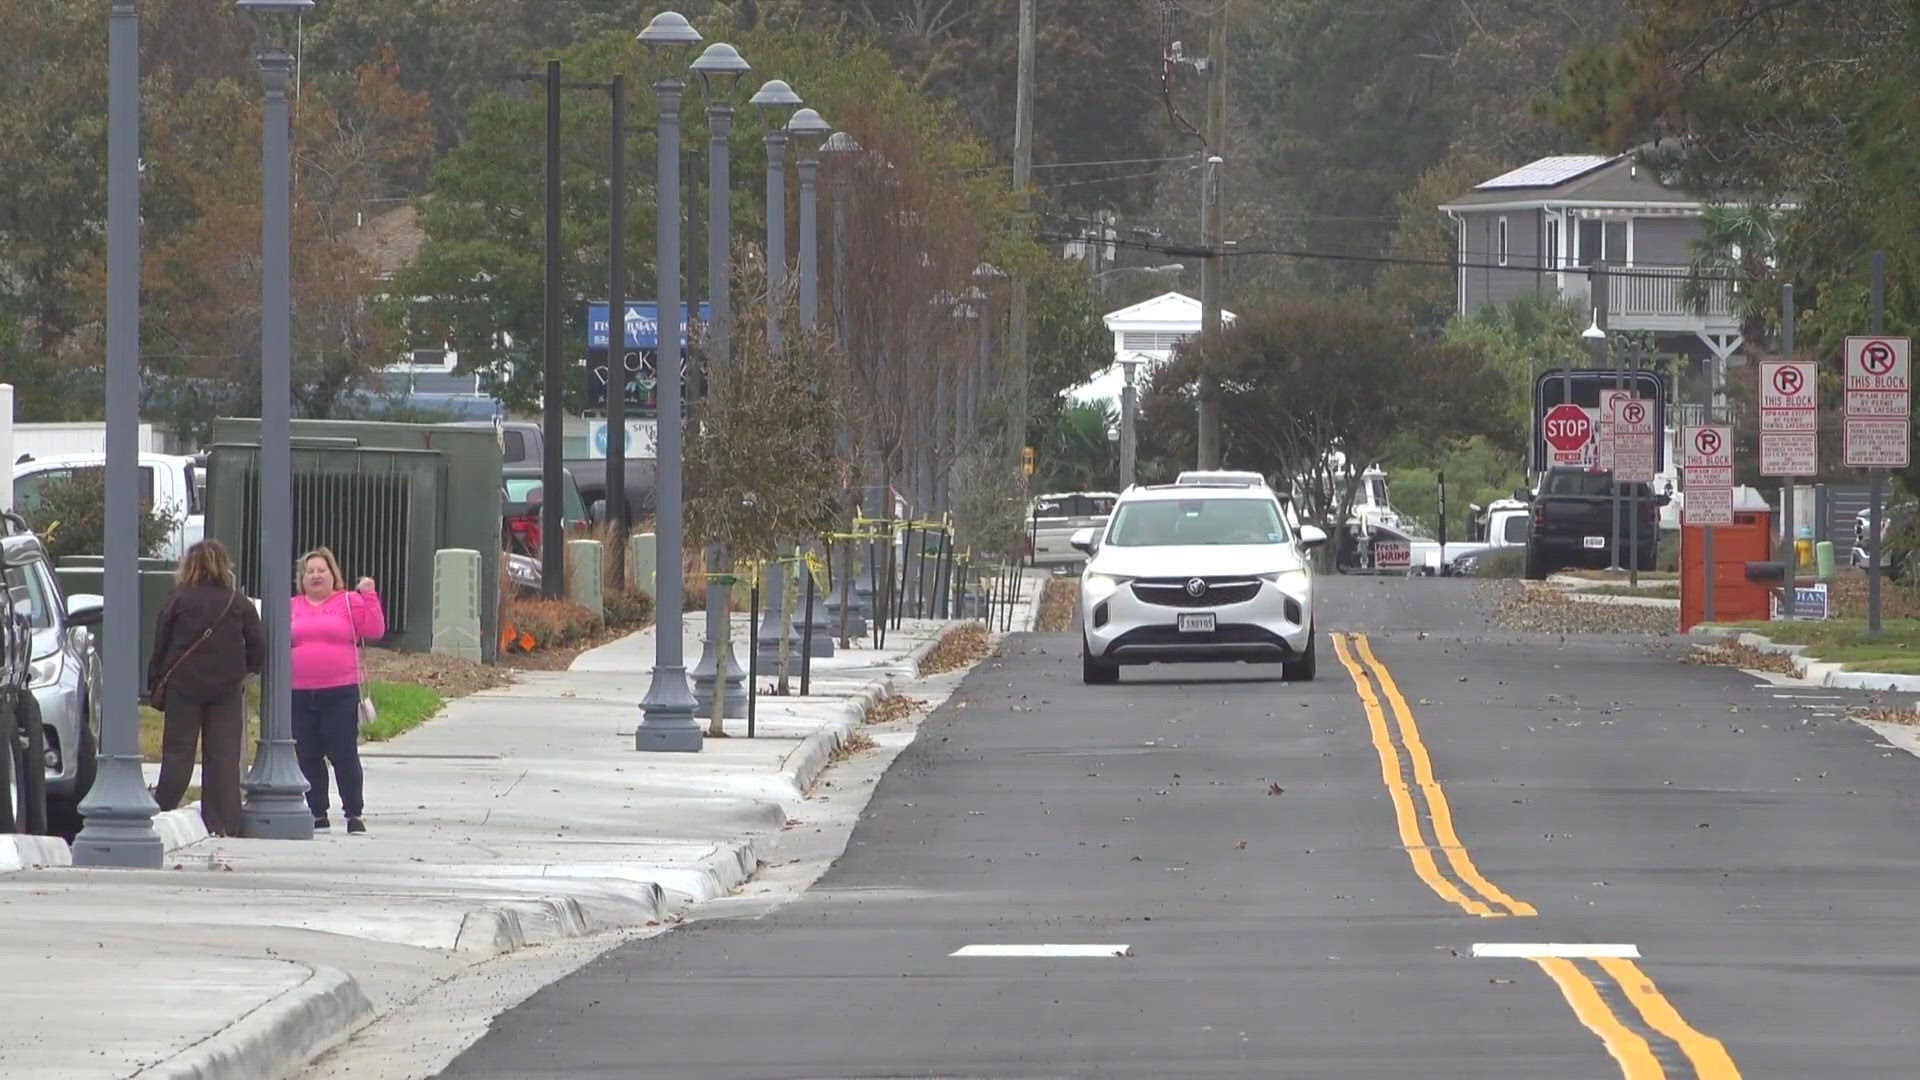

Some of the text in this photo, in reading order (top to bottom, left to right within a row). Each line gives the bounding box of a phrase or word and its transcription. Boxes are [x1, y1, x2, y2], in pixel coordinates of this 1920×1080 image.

[1851, 375, 1905, 388] THIS BLOCK
[1765, 395, 1812, 407] THIS BLOCK
[1547, 420, 1588, 438] STOP
[1687, 456, 1730, 465] THIS BLOCK
[1376, 551, 1410, 561] SHRIMP
